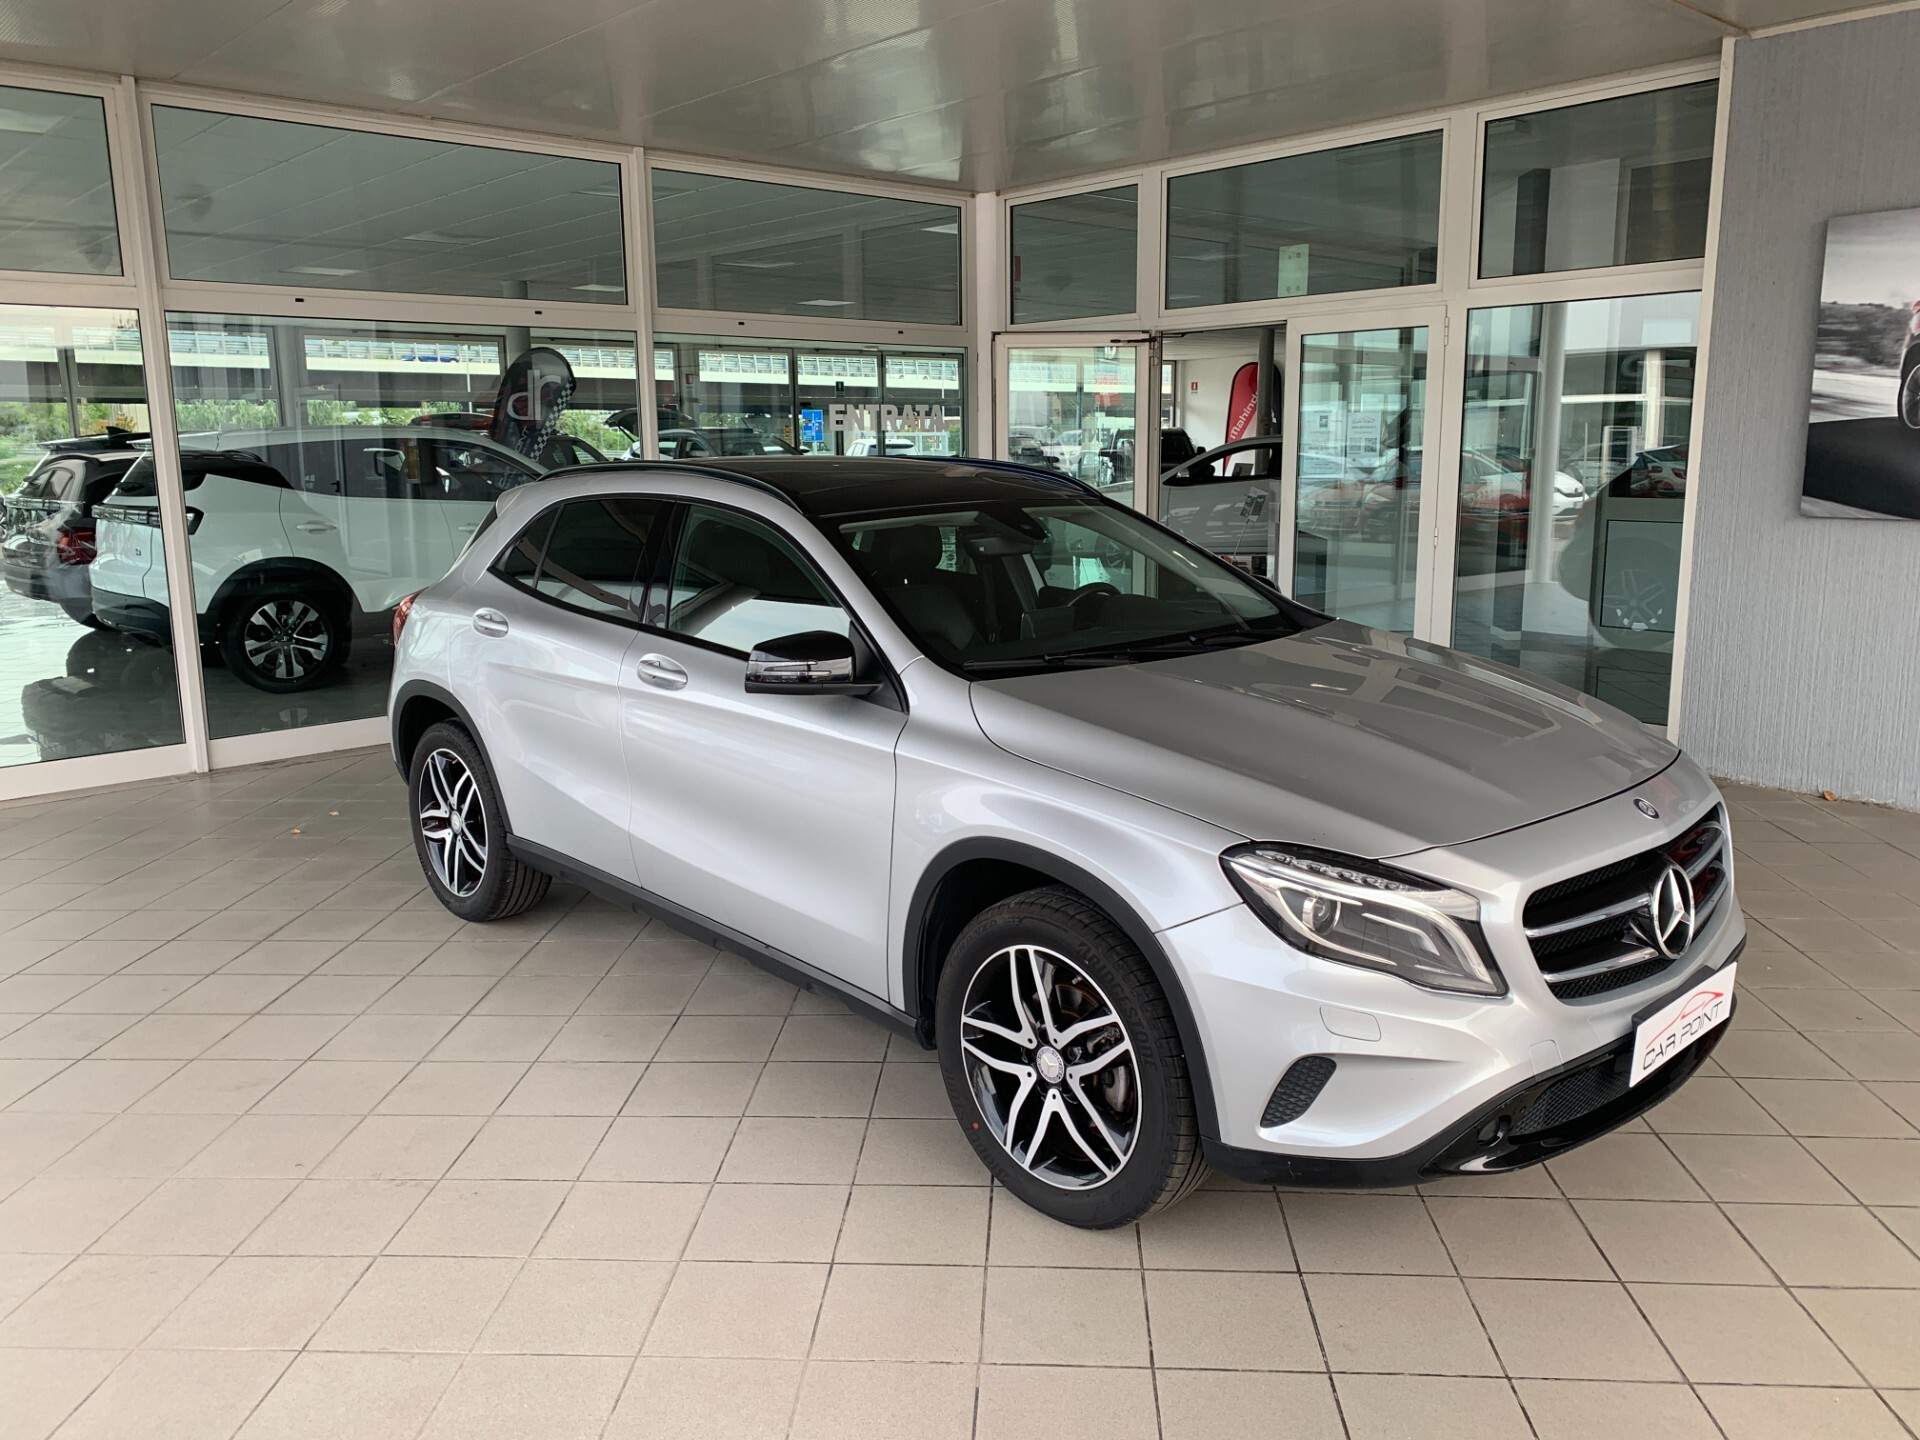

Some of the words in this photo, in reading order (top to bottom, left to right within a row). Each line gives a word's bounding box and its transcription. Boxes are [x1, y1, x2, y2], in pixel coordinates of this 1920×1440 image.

[828, 403, 944, 431] ENTRATA
[1643, 1032, 1676, 1071] CAR
[1680, 1001, 1723, 1044] POINT
